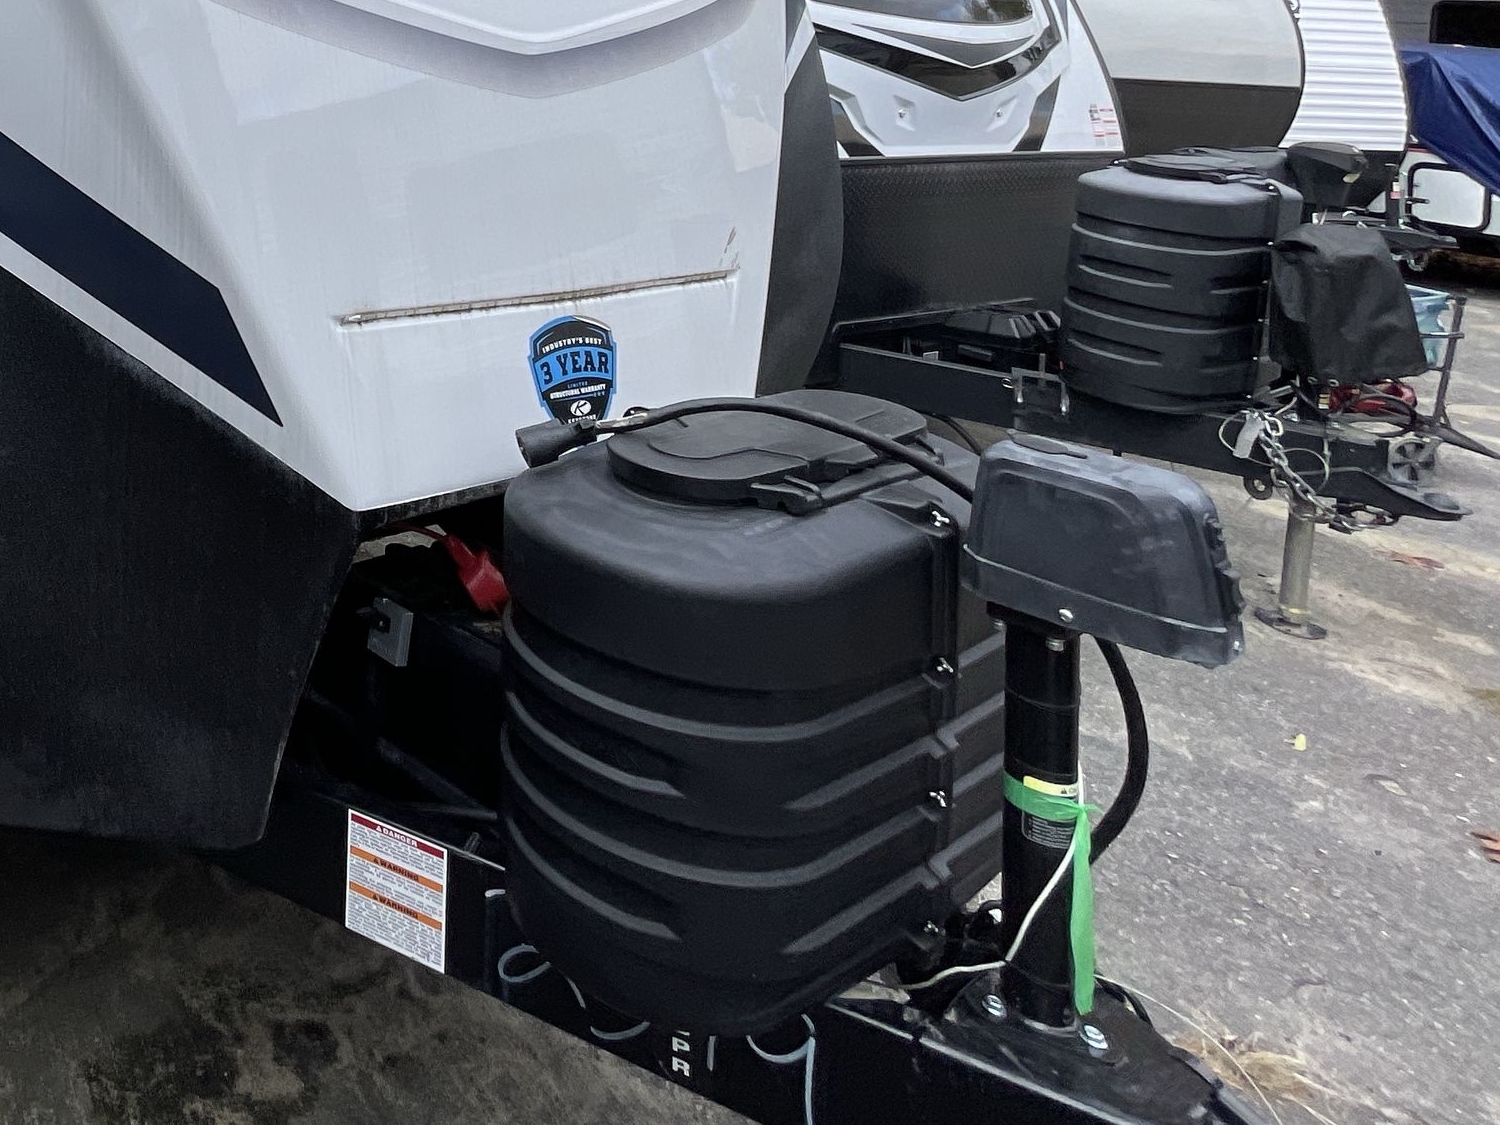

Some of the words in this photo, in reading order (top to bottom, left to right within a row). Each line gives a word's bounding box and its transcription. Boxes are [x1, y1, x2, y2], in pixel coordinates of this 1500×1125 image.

[541, 337, 583, 354] INDUSTRY'S
[585, 337, 602, 345] BEST
[541, 362, 553, 385] 3
[556, 350, 609, 376] YEAR
[383, 827, 418, 848] DANGER
[380, 860, 419, 882] WARNING
[379, 896, 418, 919] WARNING
[671, 1030, 691, 1077] PR
